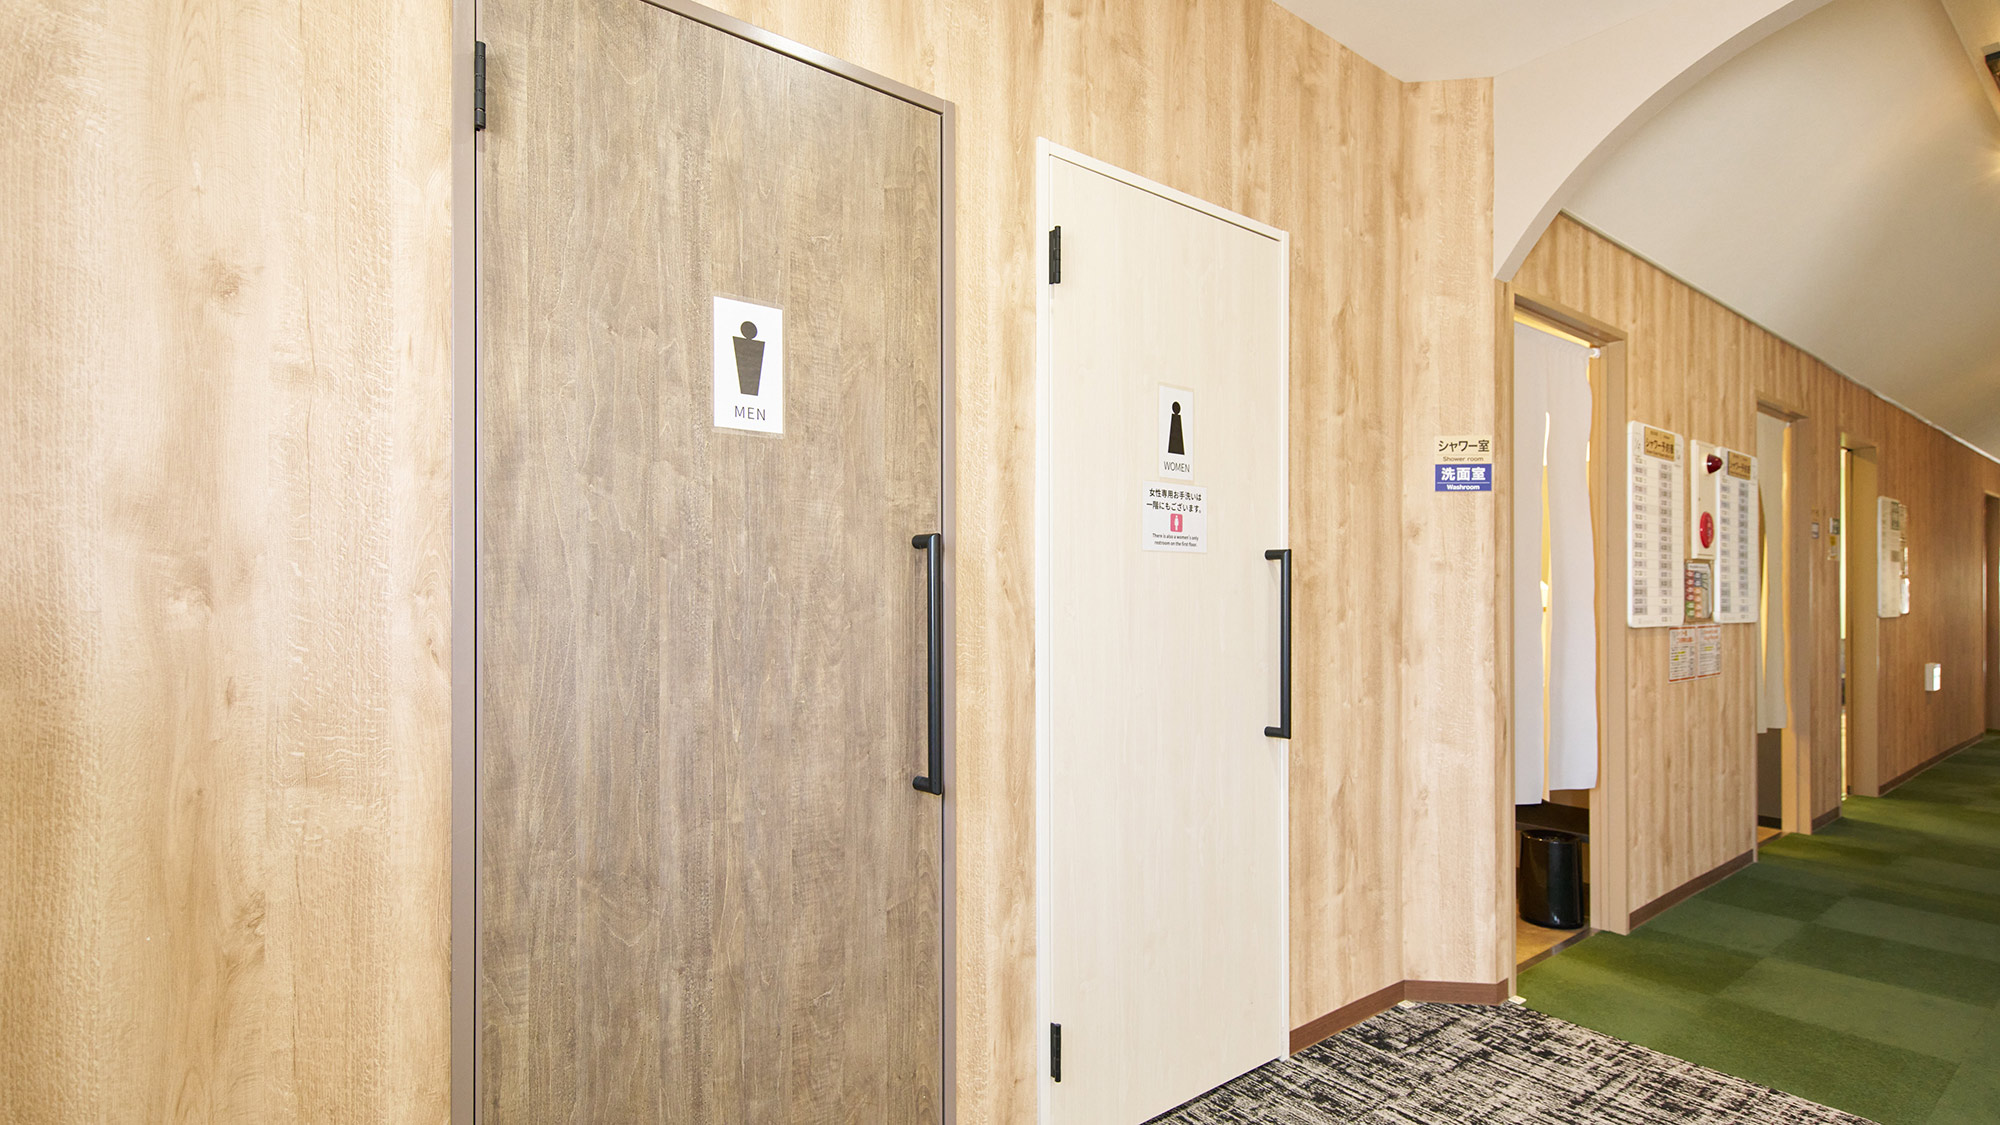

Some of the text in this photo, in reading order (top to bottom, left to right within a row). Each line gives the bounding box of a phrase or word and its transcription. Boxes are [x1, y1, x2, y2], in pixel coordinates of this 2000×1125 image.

[735, 405, 766, 421] MEN
[1438, 439, 1490, 452] シャワー室
[1164, 461, 1190, 472] WOMEN
[1441, 466, 1486, 481] 洗面室
[1149, 488, 1201, 500] 女性専用お手洗いは
[1146, 500, 1201, 513] 一階にもございます。
